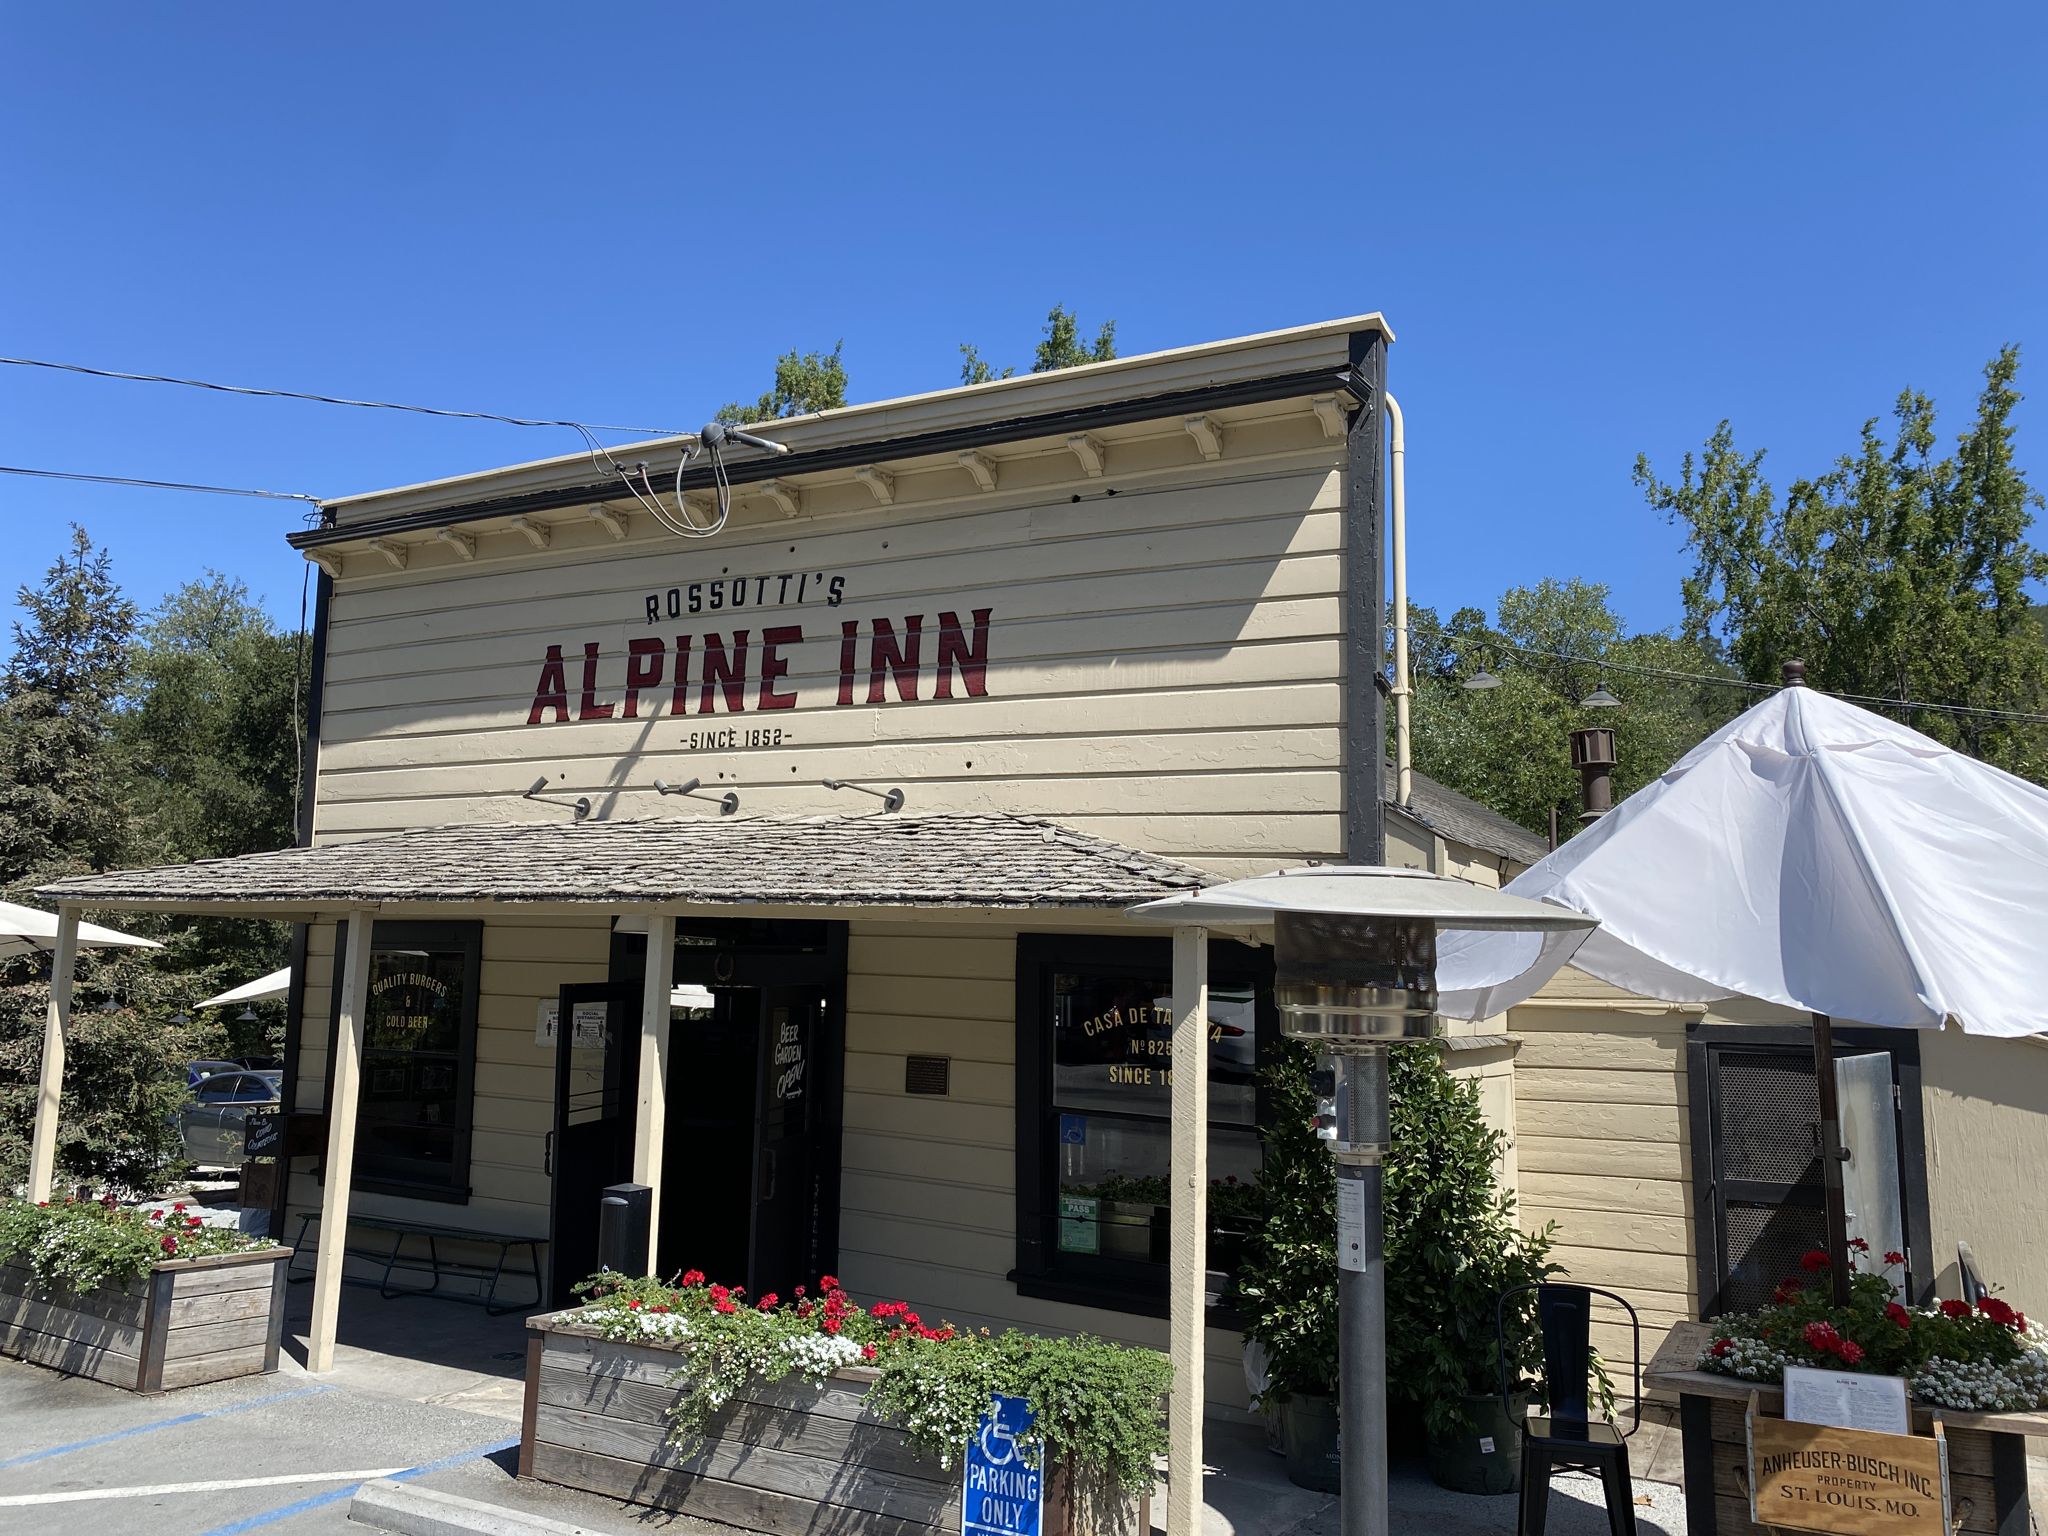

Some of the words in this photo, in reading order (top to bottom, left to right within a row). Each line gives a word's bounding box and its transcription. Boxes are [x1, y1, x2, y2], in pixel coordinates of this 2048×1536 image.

[645, 573, 846, 625] ROSSOTTI'S
[526, 625, 804, 725] ALPINE
[836, 608, 993, 706] INN
[372, 973, 407, 996] QUALITY
[409, 973, 448, 998] BURGERS
[405, 995, 411, 1007] &
[386, 1015, 405, 1028] COLD
[407, 1015, 429, 1029] BEER
[1083, 1008, 1124, 1037] CASA
[1129, 1007, 1148, 1024] DE
[1109, 1065, 1152, 1085] SINCE
[1068, 1204, 1090, 1214] PASS
[969, 1463, 1037, 1502] PARKING
[1762, 1451, 1900, 1484] ANHEUSER-BUSCH
[1904, 1470, 1935, 1500] INC.
[1817, 1474, 1876, 1492] PROPERTY
[982, 1496, 1024, 1530] ONLY
[1780, 1485, 1810, 1502] ST.
[1886, 1501, 1920, 1518] MO.
